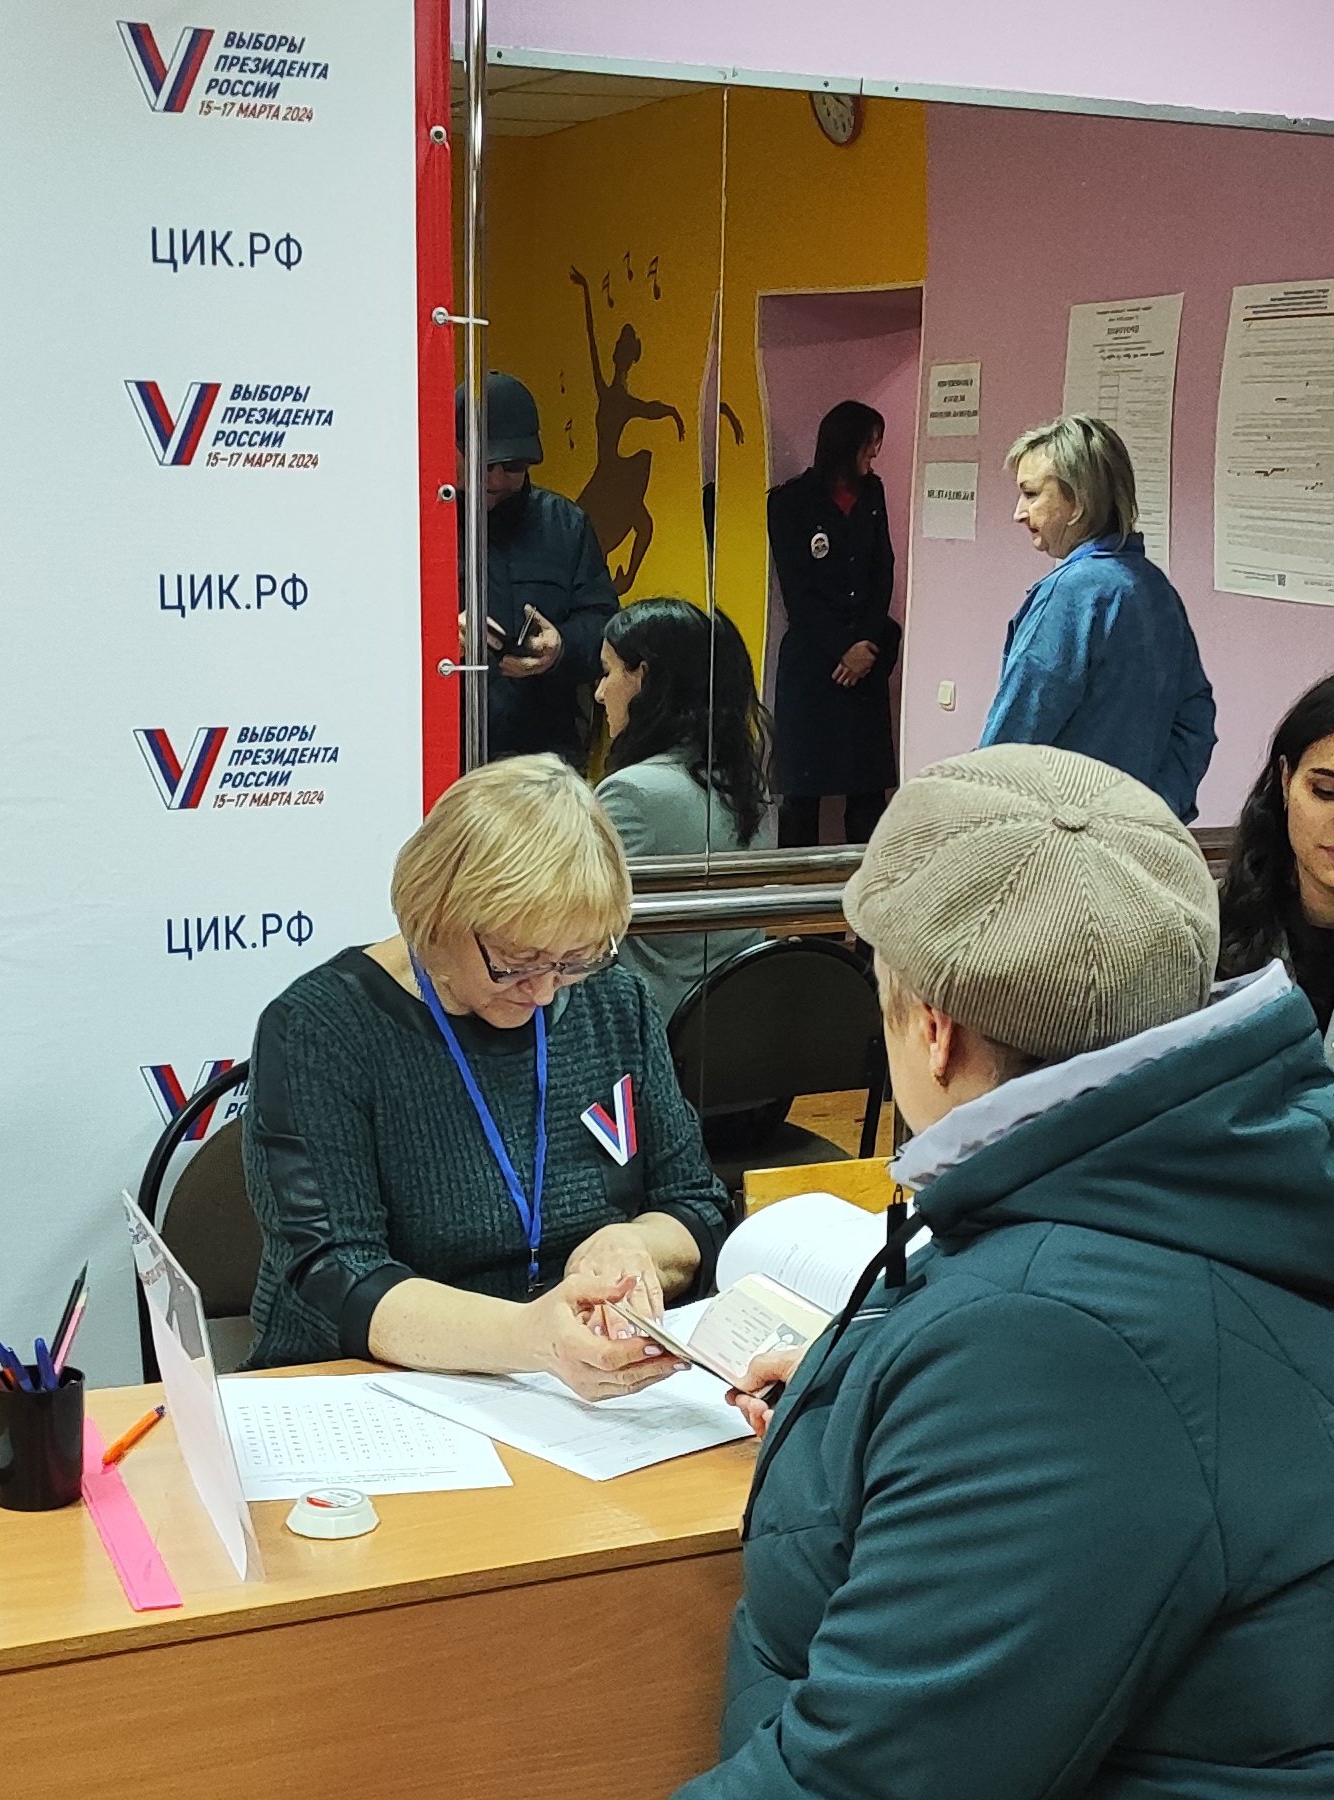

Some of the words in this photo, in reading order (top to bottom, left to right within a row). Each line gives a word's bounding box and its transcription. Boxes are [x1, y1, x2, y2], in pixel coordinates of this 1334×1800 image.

[223, 30, 306, 54] ВЫБОРЫ
[214, 54, 329, 80] ПРЕЗИДЕНТА
[205, 78, 281, 99] РОССИИ
[237, 104, 281, 120] МАРТА
[282, 106, 313, 123] 2024
[151, 226, 302, 273] ЦИК.РФ
[229, 384, 311, 403] ВЫБОРЫ
[220, 407, 333, 428] ПРЕЗИДЕНТА
[212, 429, 286, 448] РОССИИ
[243, 452, 286, 468] МАРТА
[289, 454, 318, 469] 2024
[160, 573, 308, 619] ЦИК.РФ
[237, 725, 317, 743] ВЫБОРЫ
[227, 746, 339, 767] ПРЕЗИДЕНТА
[219, 770, 292, 789] РОССИИ
[249, 791, 292, 807] МАРТА
[293, 790, 324, 805] 2024
[167, 910, 313, 961] ЦИК.РФ
